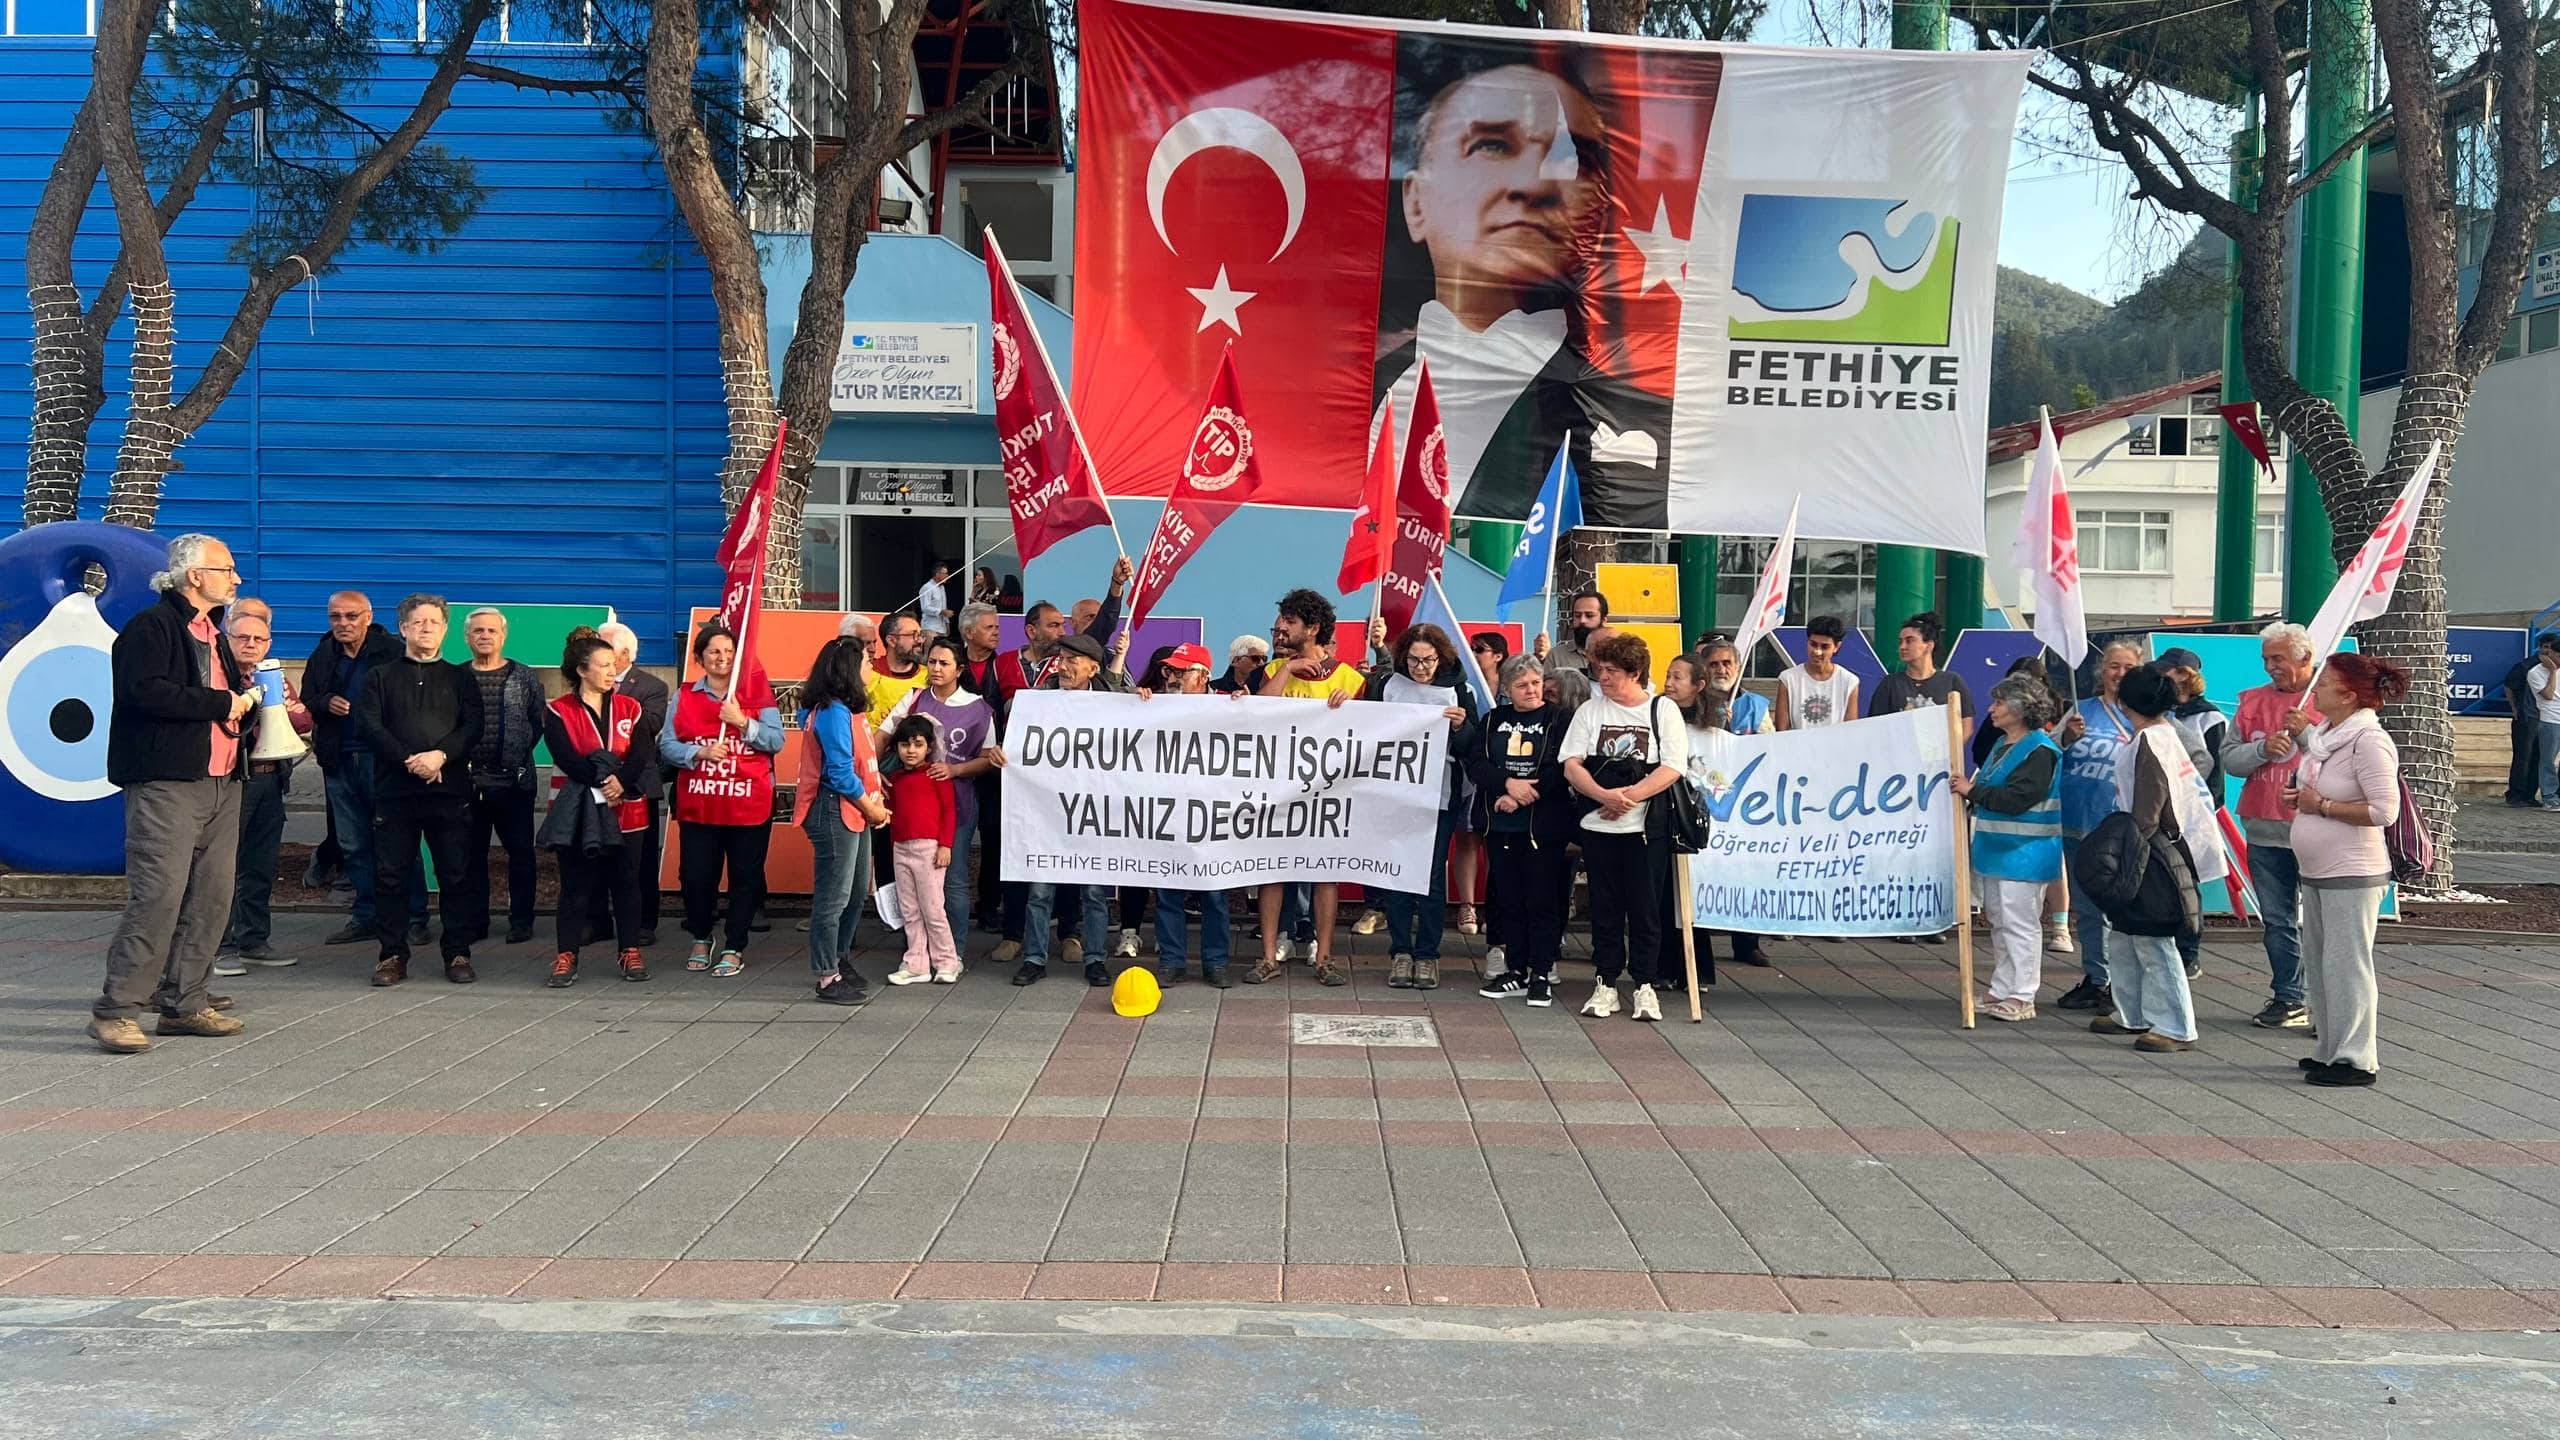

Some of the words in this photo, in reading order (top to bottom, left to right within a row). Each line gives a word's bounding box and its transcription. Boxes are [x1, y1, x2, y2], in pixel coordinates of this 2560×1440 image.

[881, 364, 935, 385] Olgun
[1728, 346, 1960, 386] FETHİYE
[1727, 385, 1957, 412] BELEDİYESİ
[1203, 422, 1236, 457] TİP
[1383, 570, 1425, 599] PAR
[1022, 725, 1145, 773] DORUK
[1155, 729, 1277, 779] MADEN
[1288, 725, 1430, 793] İŞÇİLERİ
[688, 777, 752, 797] PARTİSİ
[1703, 751, 1950, 828] Veli-der
[1058, 791, 1176, 842] YALNIZ
[1186, 790, 1353, 843] DEĞİLDİR!
[1710, 829, 1790, 856] Öğrenci
[1800, 832, 1839, 854] Veli
[1848, 823, 1929, 849] Derneği
[1026, 853, 1102, 871] FETHİYE
[1107, 855, 1188, 878] BİRLEŞİK
[1193, 856, 1288, 878] MÜCADELE
[1294, 856, 1402, 878] PLATFORMU
[1776, 855, 1866, 880] FETHİYE
[1696, 882, 1826, 921] ÇOCUKLARIMIZIN
[1832, 873, 1904, 922] GELECEĞİ
